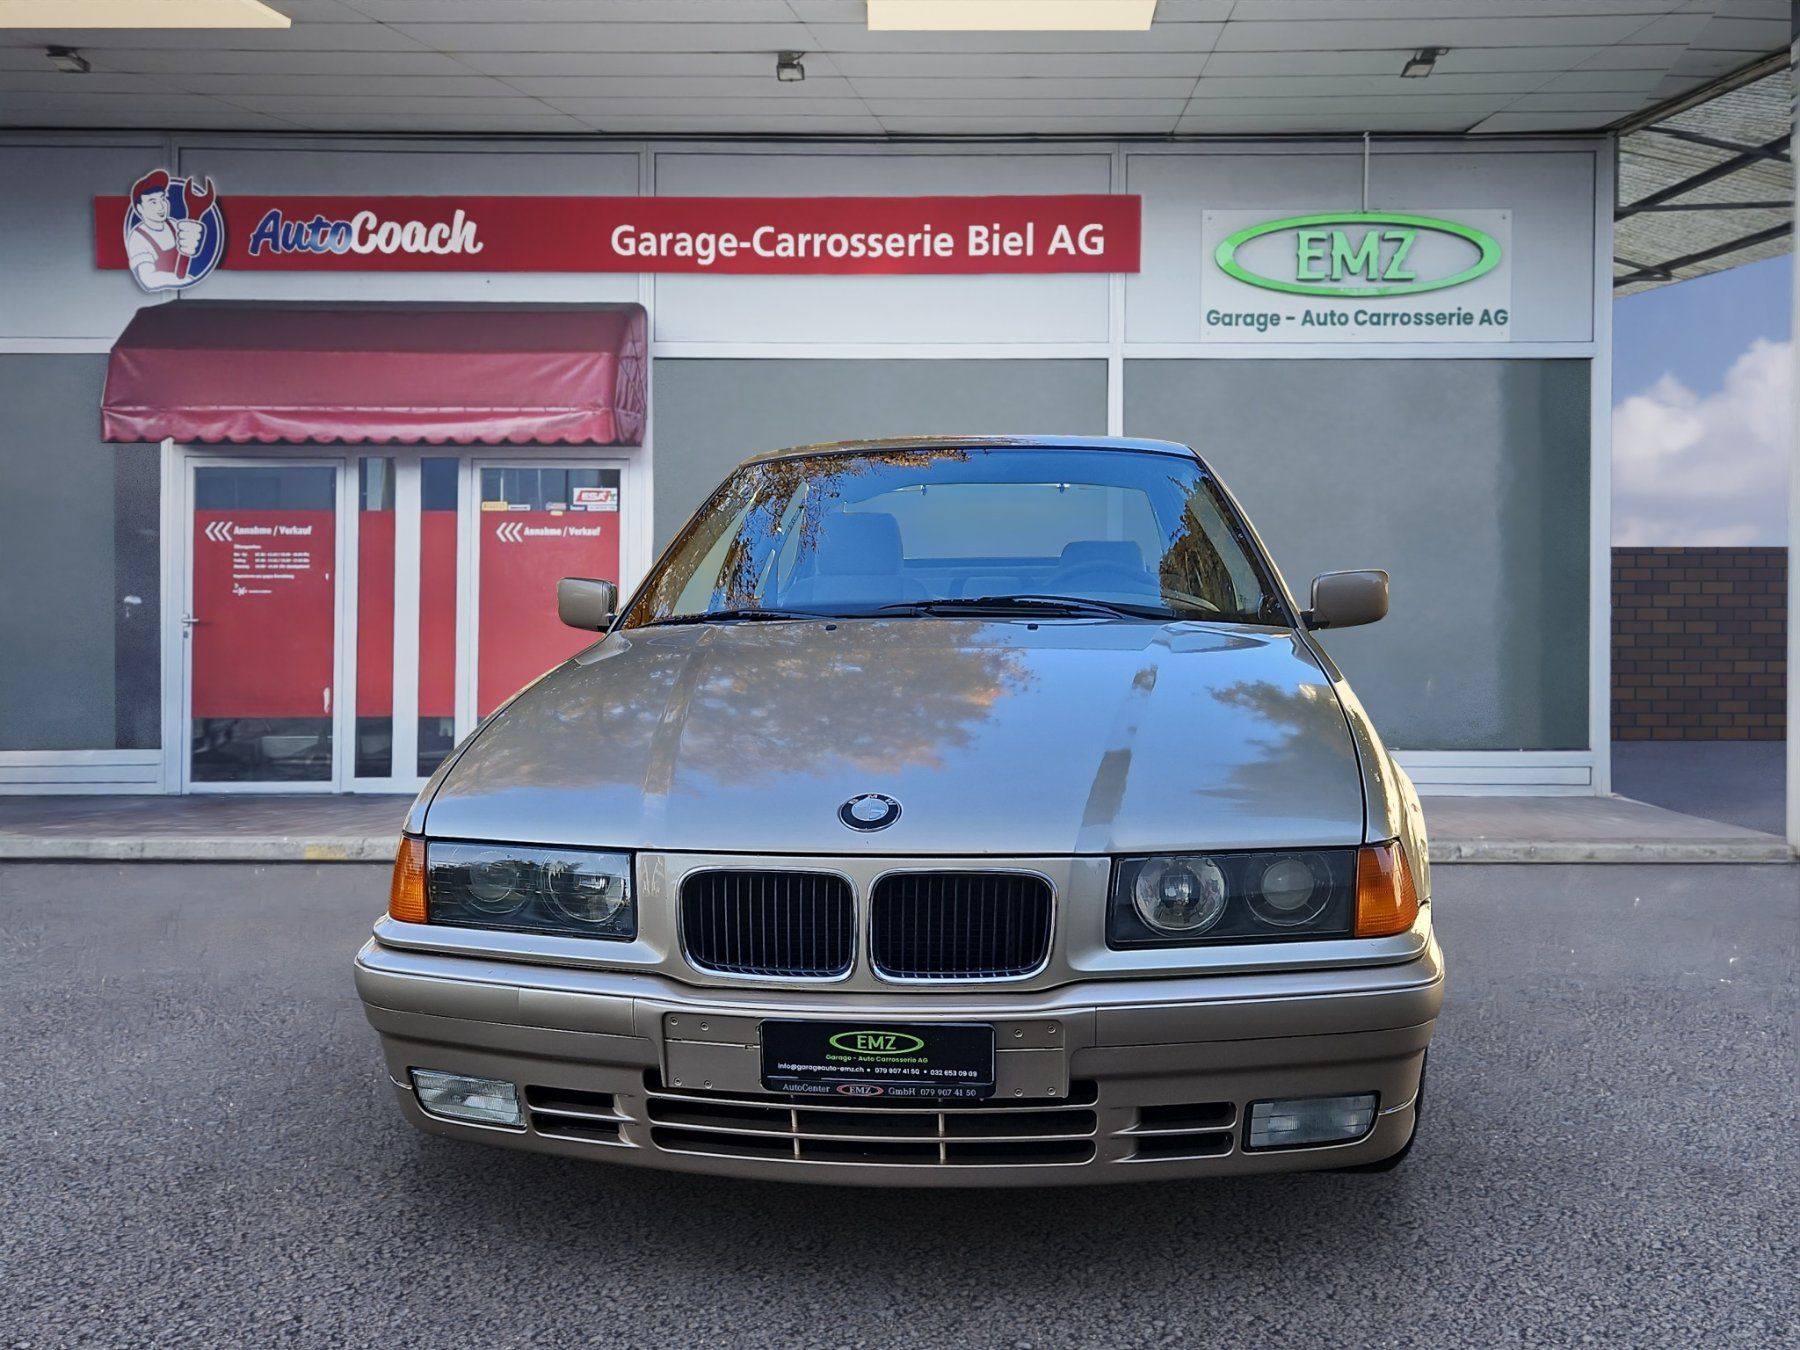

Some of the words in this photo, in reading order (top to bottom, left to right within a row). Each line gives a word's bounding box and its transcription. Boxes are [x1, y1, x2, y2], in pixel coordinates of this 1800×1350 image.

[248, 208, 484, 256] AutoCoach
[610, 223, 954, 265] Garage-Carrosserie
[967, 222, 1034, 257] Biel
[1047, 223, 1105, 257] AG
[1296, 230, 1418, 281] EMZ
[1206, 309, 1281, 332] Garage
[1301, 309, 1349, 327] Auto
[1353, 307, 1474, 327] Carrosserie
[1478, 308, 1509, 326] AG
[233, 525, 272, 535] Annahme
[279, 525, 312, 535] Verkauf
[523, 526, 562, 536] Annahme
[568, 526, 601, 536] Verkauf
[856, 1035, 897, 1050] EMZ
[825, 1054, 852, 1062] Garage
[782, 1083, 830, 1093] AutoCenter
[849, 1086, 872, 1094] EMZ
[888, 1087, 916, 1095] GmbH
[937, 1088, 952, 1096] 907
[953, 1088, 963, 1096] 41
[966, 1088, 977, 1096] 50
